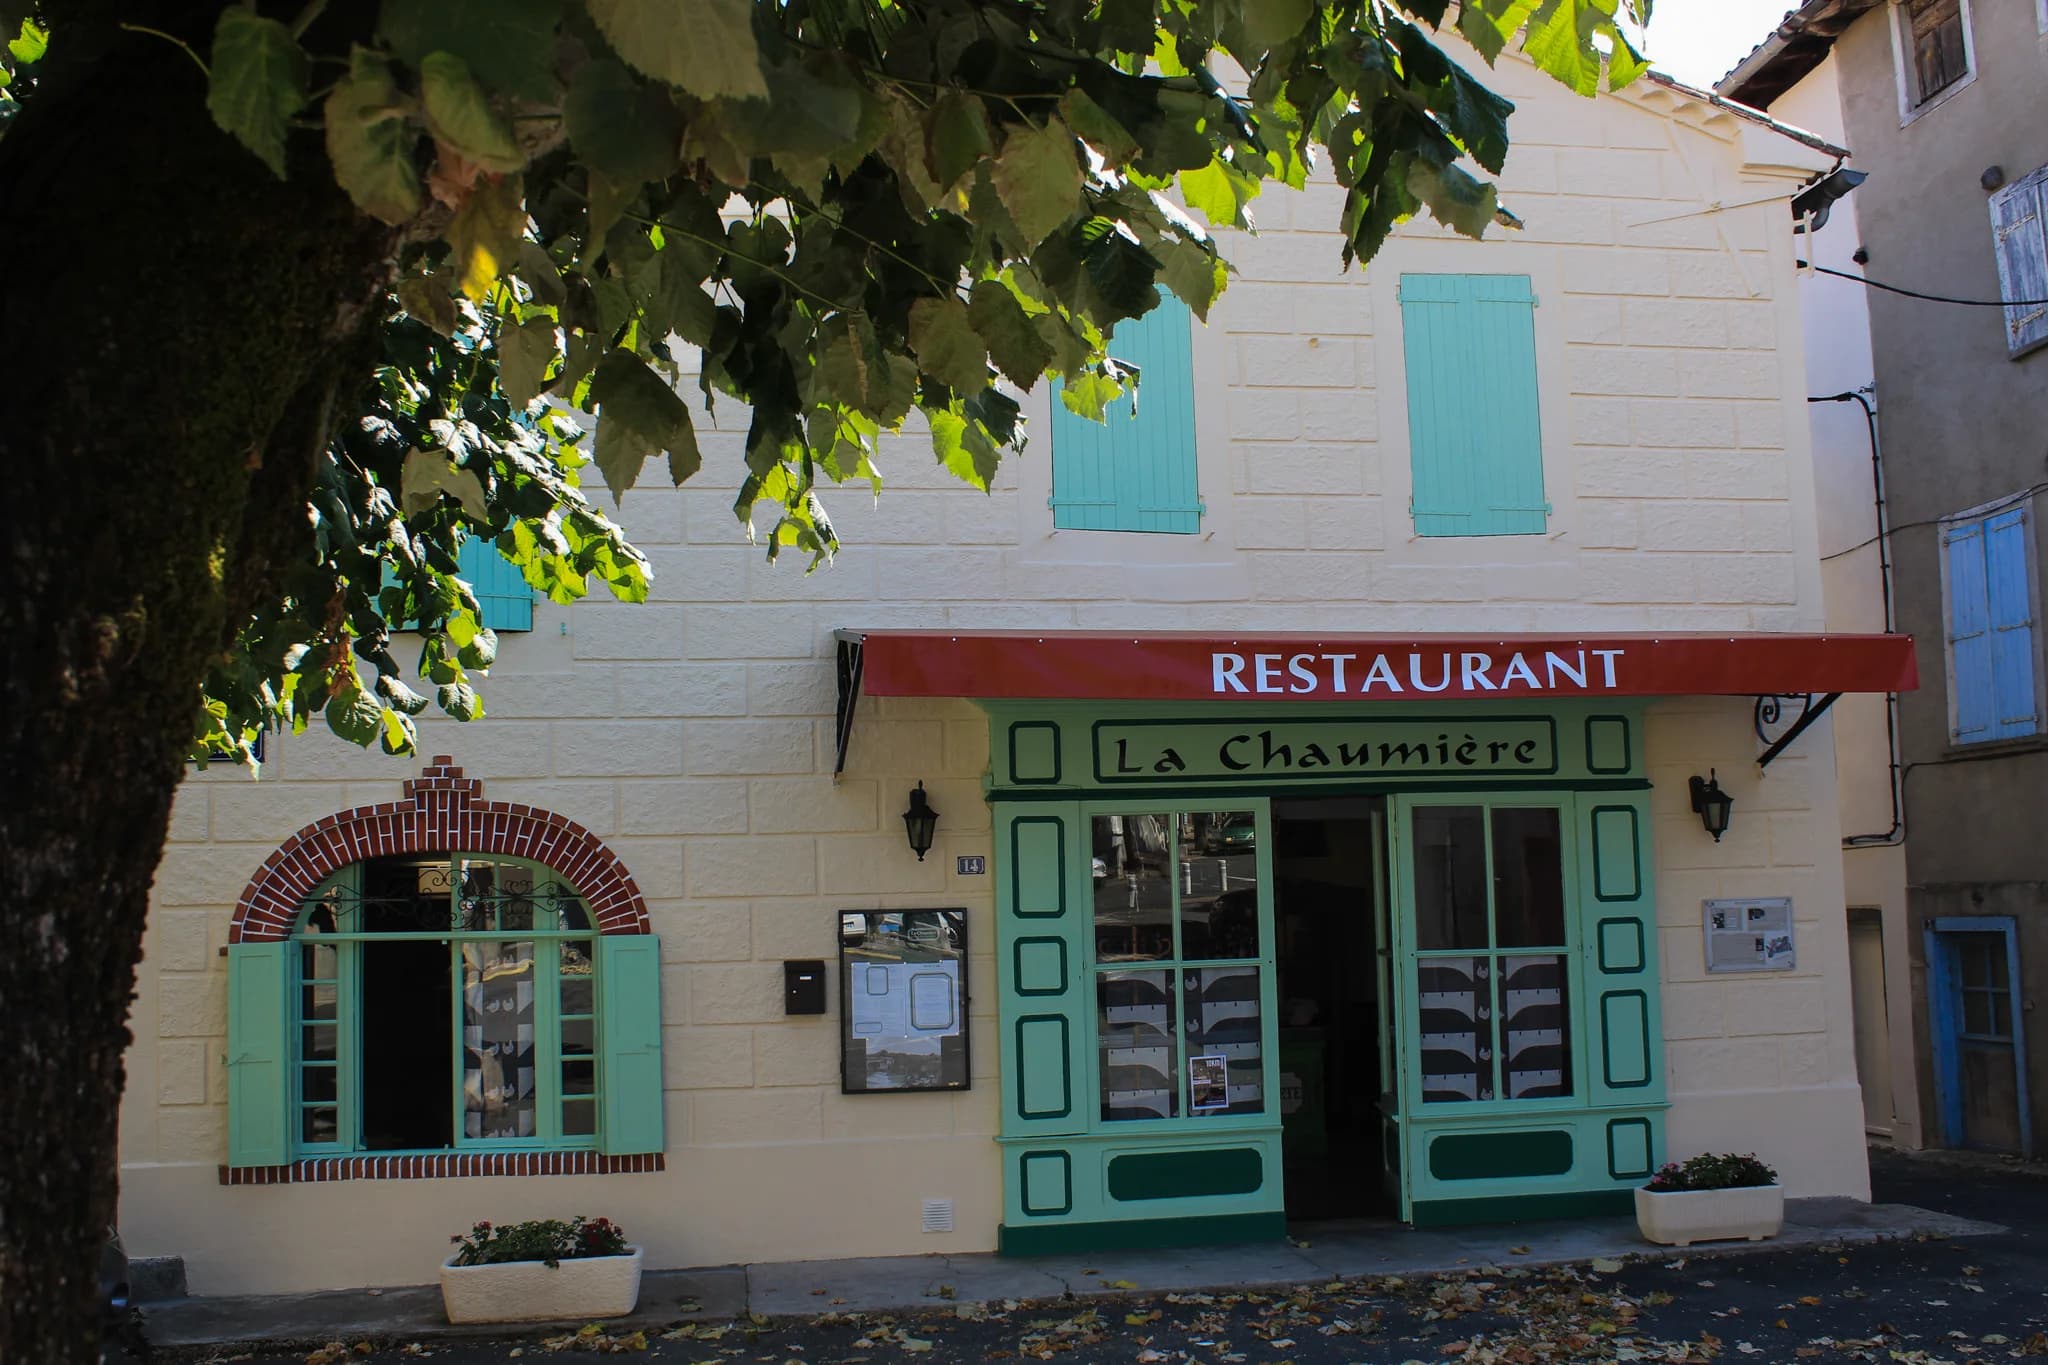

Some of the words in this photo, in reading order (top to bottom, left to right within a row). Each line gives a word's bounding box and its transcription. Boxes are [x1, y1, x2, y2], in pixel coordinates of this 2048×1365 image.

[1212, 650, 1625, 694] RESTAURANT
[1114, 738, 1186, 773] La
[1219, 731, 1537, 770] Chaumière
[964, 859, 979, 872] 14
